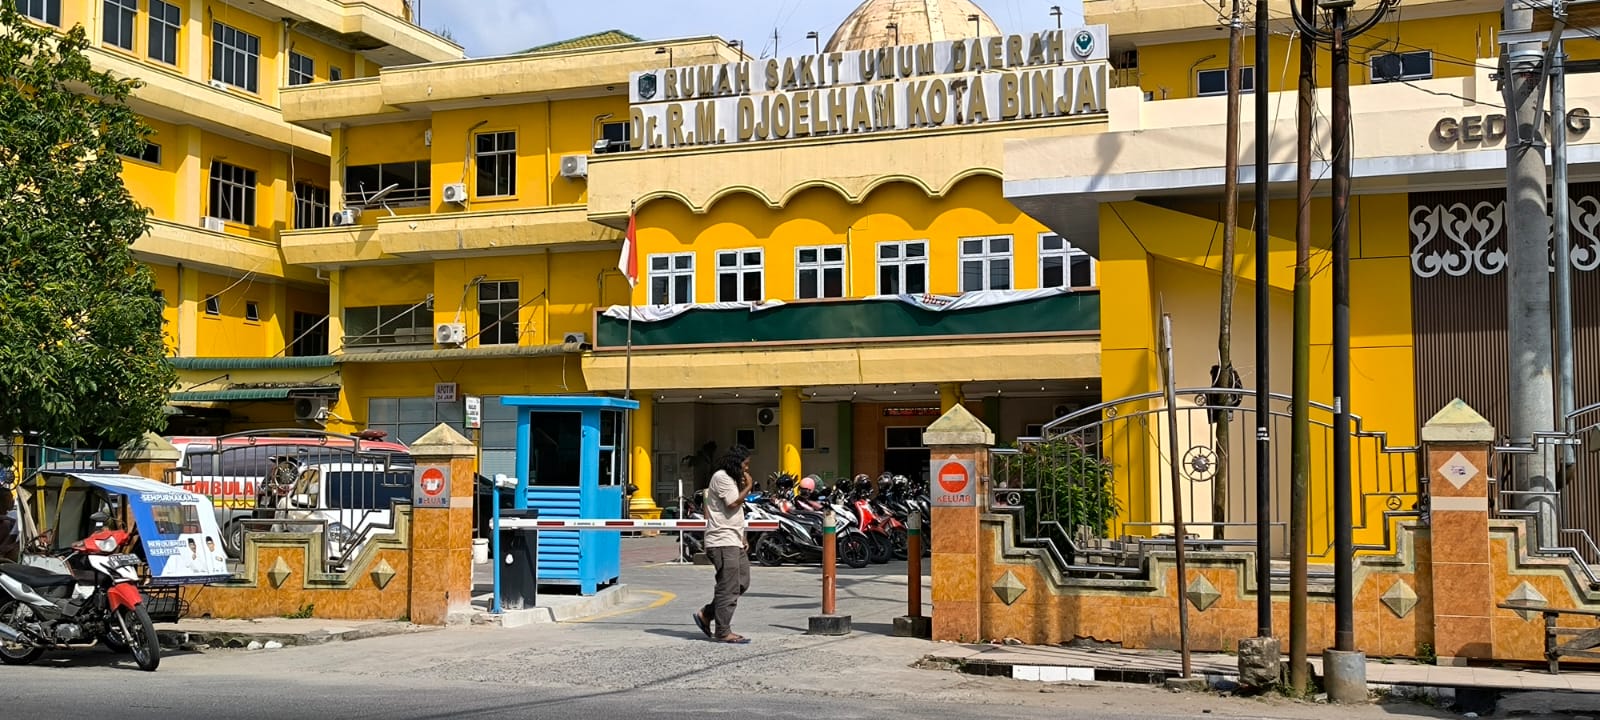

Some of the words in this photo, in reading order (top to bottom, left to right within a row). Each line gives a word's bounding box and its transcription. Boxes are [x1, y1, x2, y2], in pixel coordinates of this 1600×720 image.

[664, 61, 750, 98] RUMAH
[764, 52, 843, 89] SAKIT
[859, 42, 935, 80] UMUM
[950, 29, 1064, 73] DAERAH
[736, 83, 896, 141] DJOELHAM
[907, 75, 989, 128] KOTA
[1000, 64, 1107, 119] BINJAI
[1435, 107, 1591, 144] GEDG
[936, 494, 971, 503] KELUAR
